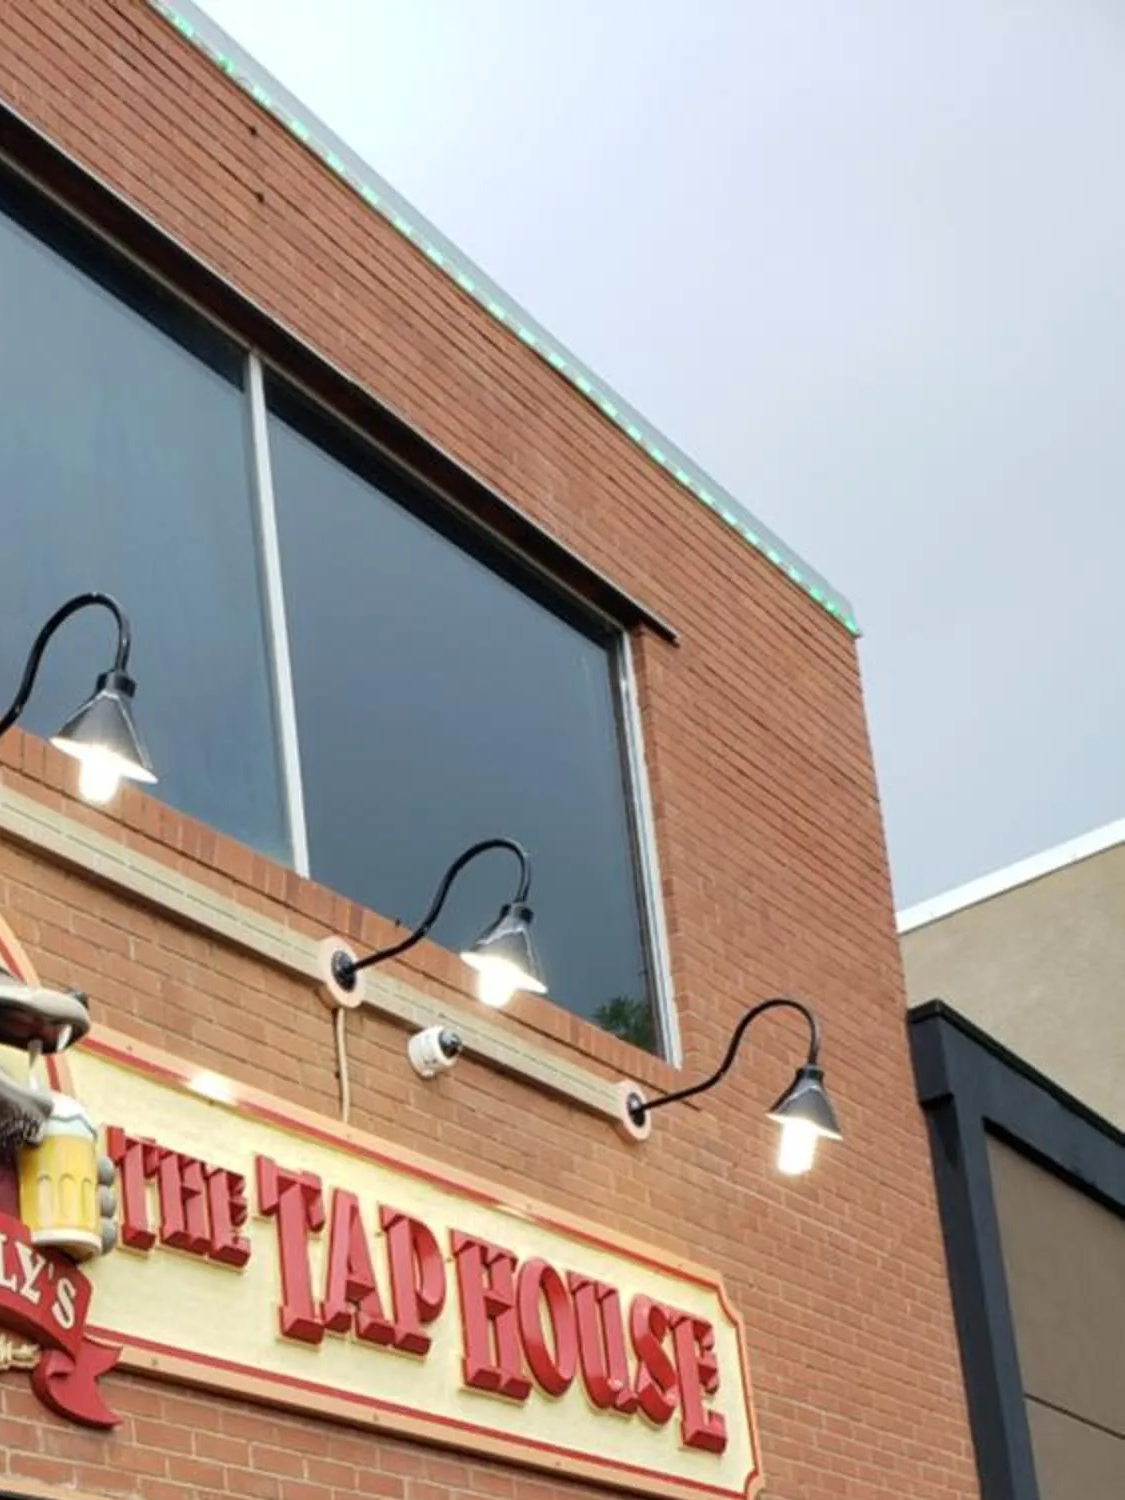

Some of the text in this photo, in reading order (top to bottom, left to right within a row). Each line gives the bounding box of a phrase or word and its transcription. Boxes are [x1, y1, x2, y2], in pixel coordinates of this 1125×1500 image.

[106, 1126, 728, 1455] THE TAP HOUSE
